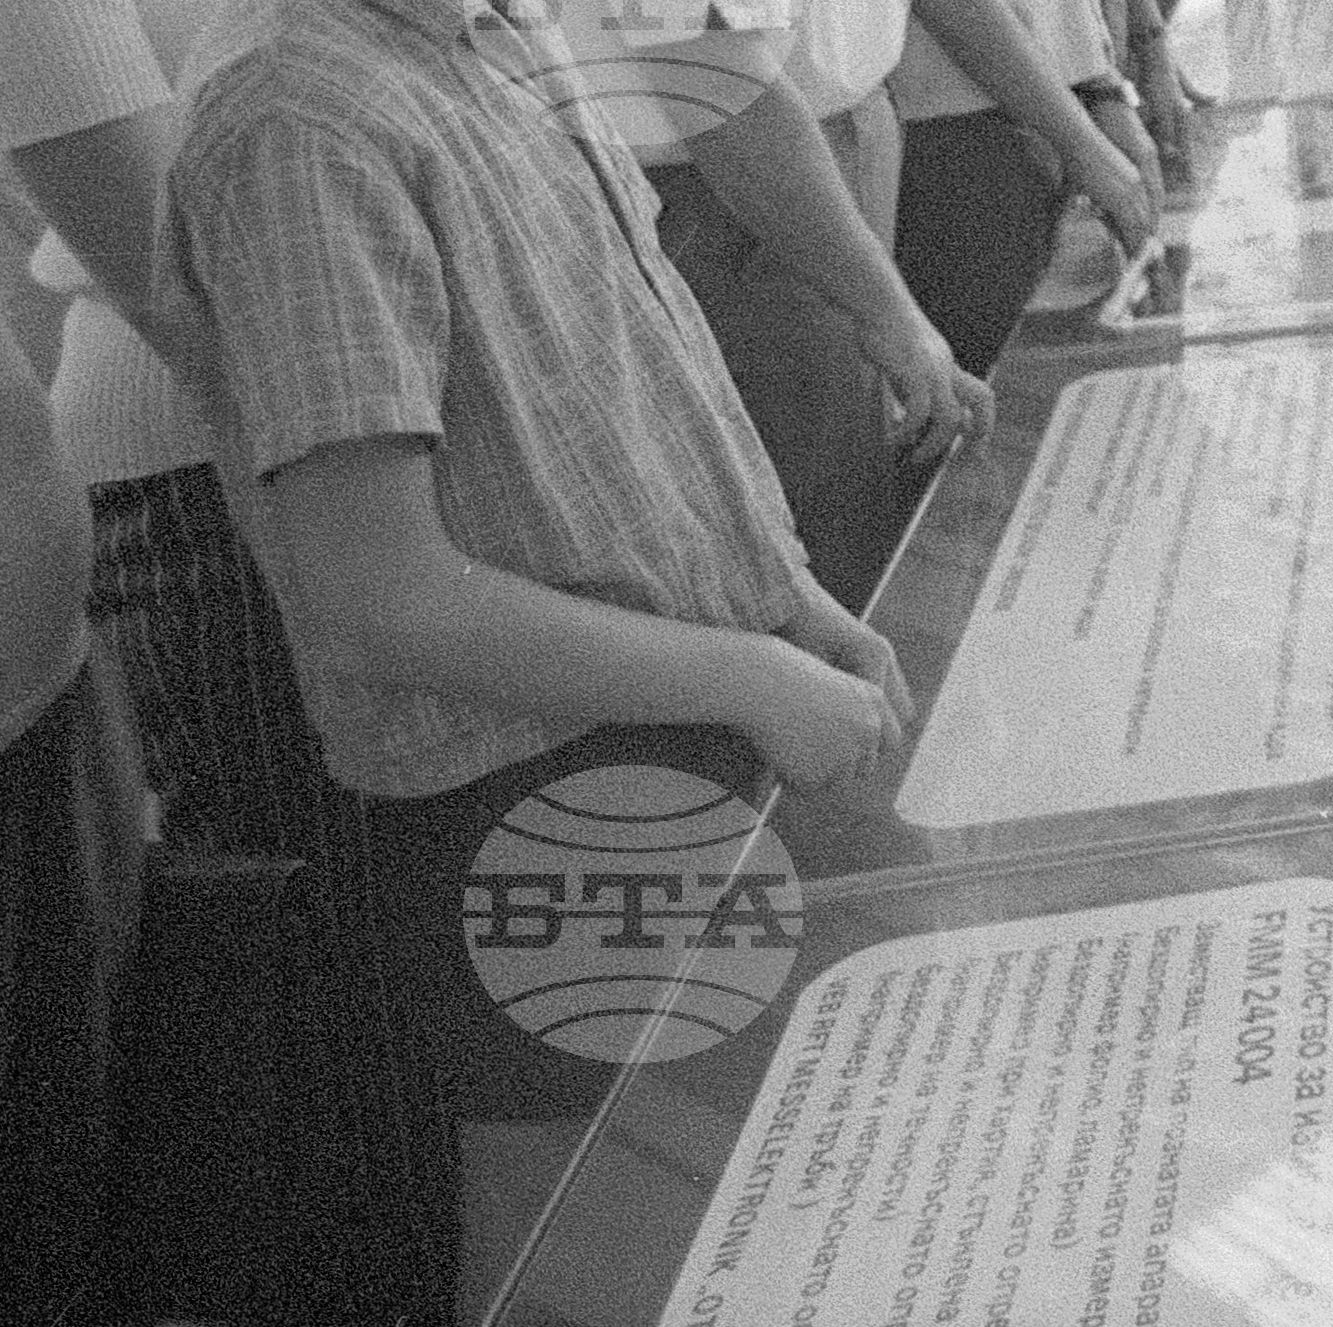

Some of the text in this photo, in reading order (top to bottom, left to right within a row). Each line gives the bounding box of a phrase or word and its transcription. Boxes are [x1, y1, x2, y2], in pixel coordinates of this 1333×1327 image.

[816, 976, 849, 1014] VEB
[1231, 910, 1286, 1085] FMM 24004
[801, 1018, 836, 1052] RFT
[1047, 1064, 1065, 1078] и
[1134, 1048, 1153, 1062] и
[915, 1071, 942, 1098] на
[959, 1080, 980, 1092] и
[996, 1055, 1028, 1097] при
[1169, 1078, 1192, 1106] на
[1294, 1066, 1326, 1101] за
[827, 1086, 855, 1113] на
[870, 1095, 890, 1108] и
[705, 1058, 820, 1277] MESSELEKTRONIK
[1098, 1067, 1151, 1239] непрекъснато
[901, 1099, 973, 1279] непрекъснато
[1048, 1120, 1098, 1250] ламарина)
[800, 1115, 881, 1296] непрекъснато
